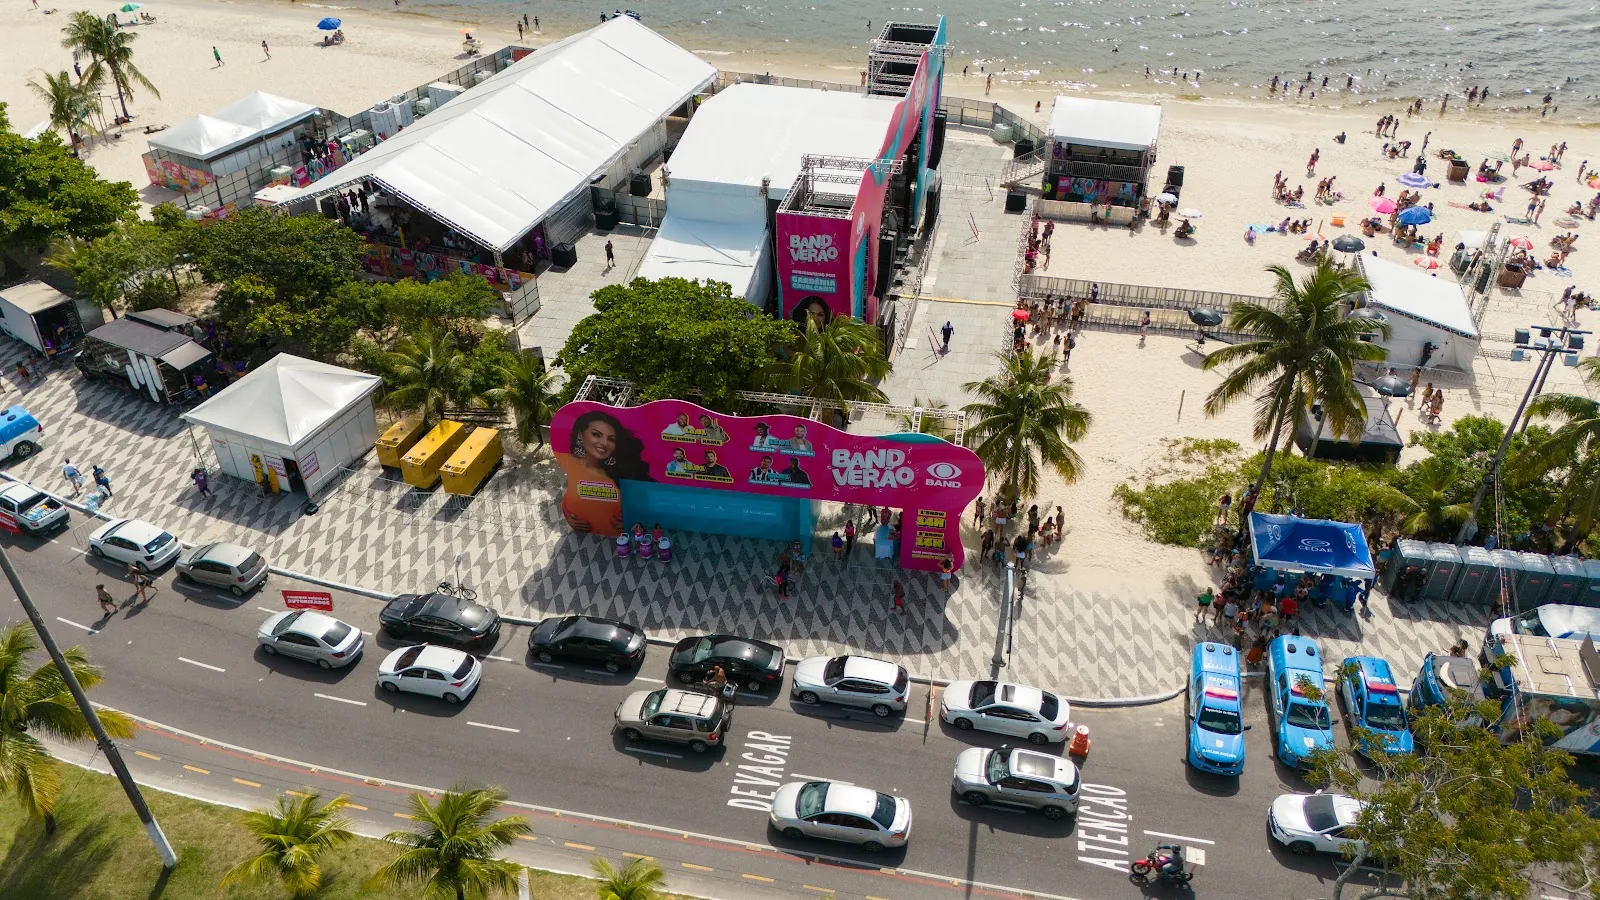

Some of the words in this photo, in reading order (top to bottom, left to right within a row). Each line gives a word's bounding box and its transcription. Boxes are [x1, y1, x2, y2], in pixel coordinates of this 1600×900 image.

[789, 234, 833, 249] BAND
[790, 246, 838, 262] VERÃO
[791, 276, 836, 287] GARDÊNIA
[792, 283, 836, 293] CAVALCANTI
[832, 449, 906, 469] BAND
[832, 465, 914, 488] VERÃO
[925, 479, 961, 488] BAND
[1298, 545, 1334, 553] CEDAE
[727, 731, 792, 812] DEVAGAR
